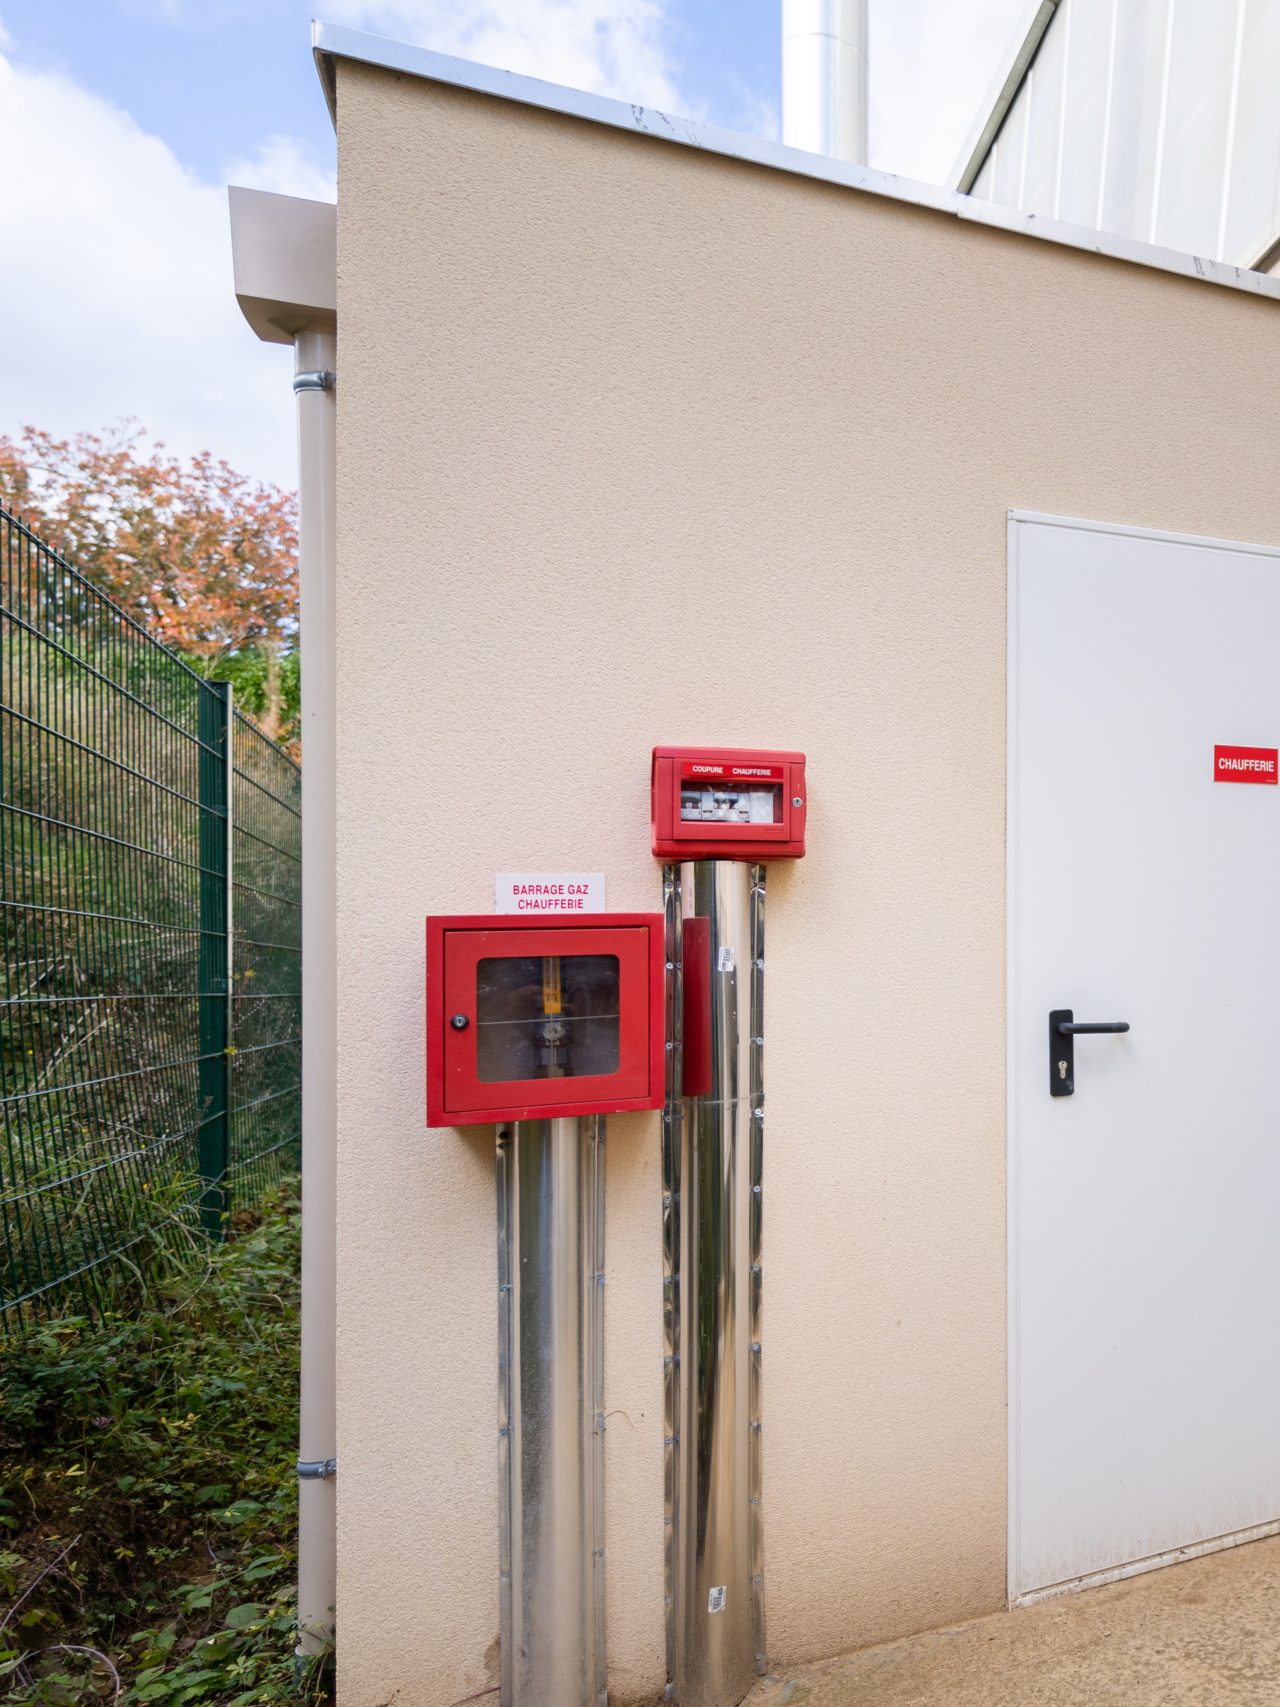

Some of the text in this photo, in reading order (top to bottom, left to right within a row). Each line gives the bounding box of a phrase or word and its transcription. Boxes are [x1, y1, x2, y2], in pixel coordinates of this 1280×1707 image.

[1218, 757, 1275, 772] CHAUFFERIE
[692, 765, 772, 776] COUPURE CHAUFFERIE
[513, 884, 589, 895] BARRAGE GAZ
[518, 899, 584, 909] CHAUFFERIE
